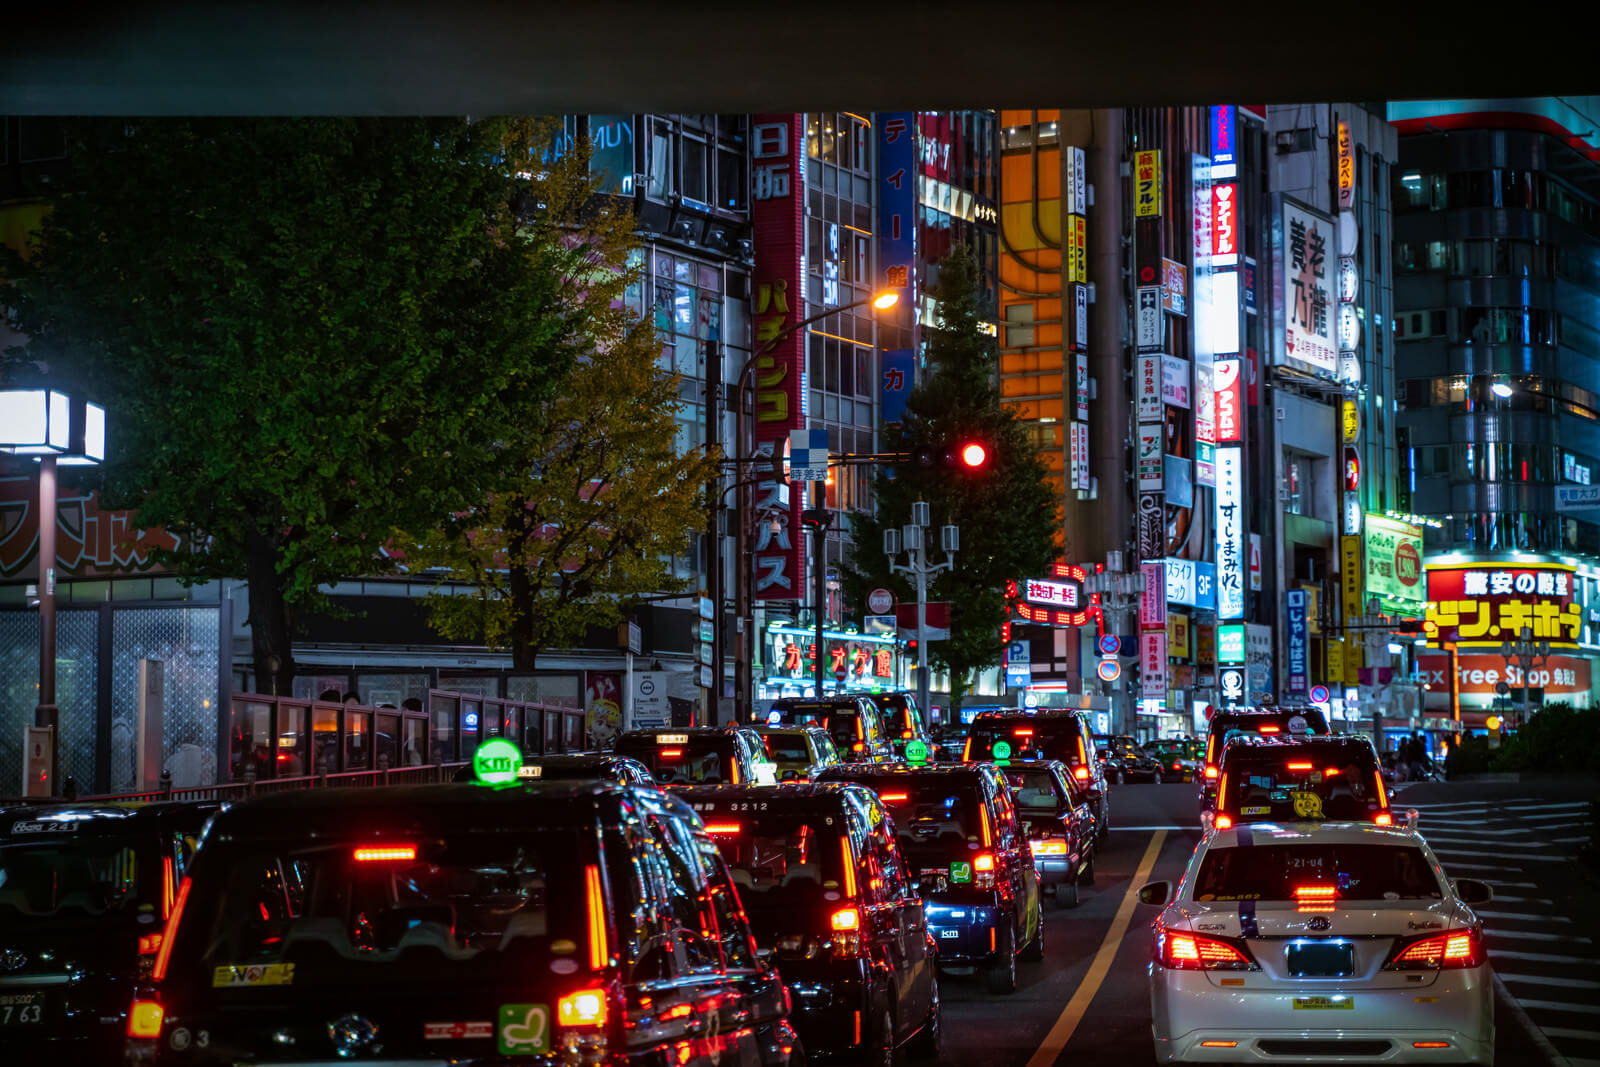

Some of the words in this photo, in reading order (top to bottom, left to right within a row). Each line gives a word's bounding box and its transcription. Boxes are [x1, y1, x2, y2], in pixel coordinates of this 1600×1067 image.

[1140, 205, 1153, 215] 6F
[1217, 200, 1232, 254] アイフル
[791, 470, 829, 480] 時差式
[1219, 501, 1240, 590] すしまみれ
[1199, 575, 1211, 596] 3F
[1010, 643, 1023, 661] P
[1418, 670, 1444, 685] ax
[1457, 665, 1499, 684] ree
[478, 754, 512, 773] km
[942, 929, 960, 938] km
[196, 1029, 210, 1046] 3
